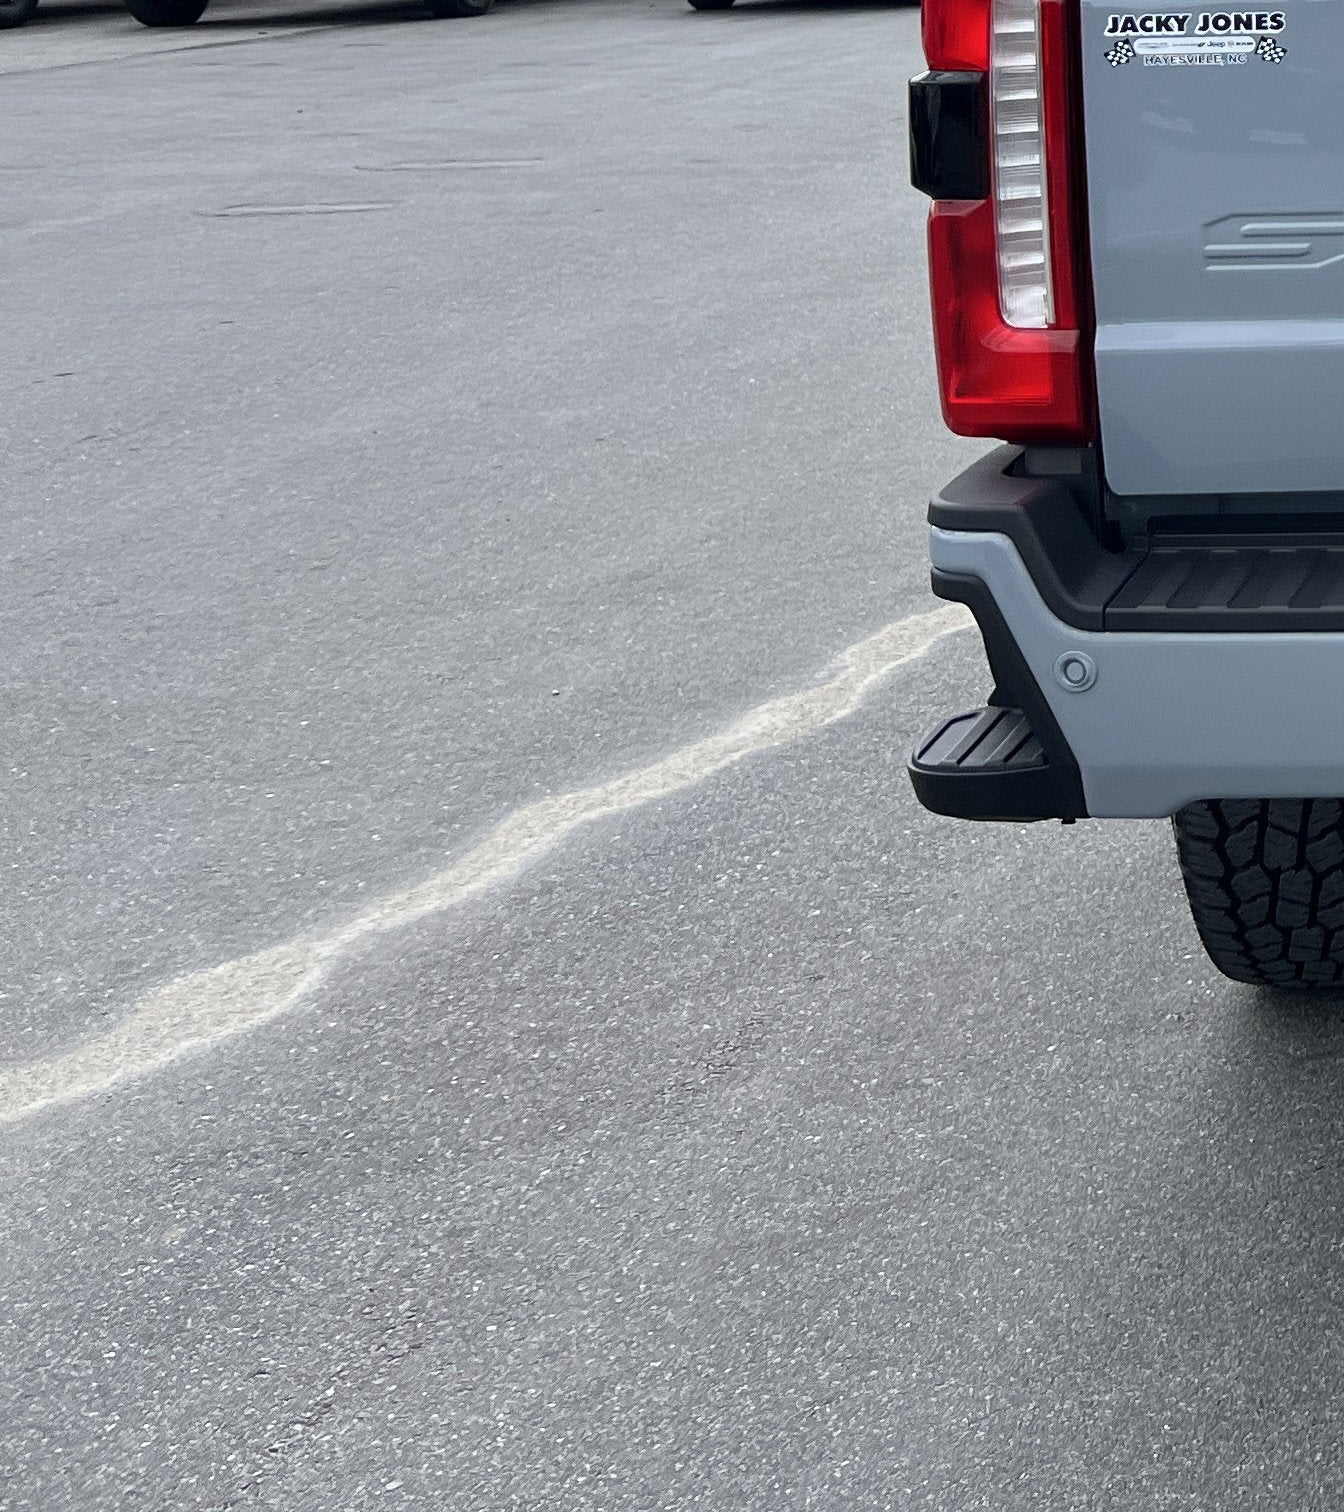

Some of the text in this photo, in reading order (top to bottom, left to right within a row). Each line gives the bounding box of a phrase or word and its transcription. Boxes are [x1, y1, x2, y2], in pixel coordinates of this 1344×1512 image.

[1104, 11, 1286, 36] JACKY JONES
[1144, 53, 1248, 67] HAYESVILLE, NC
